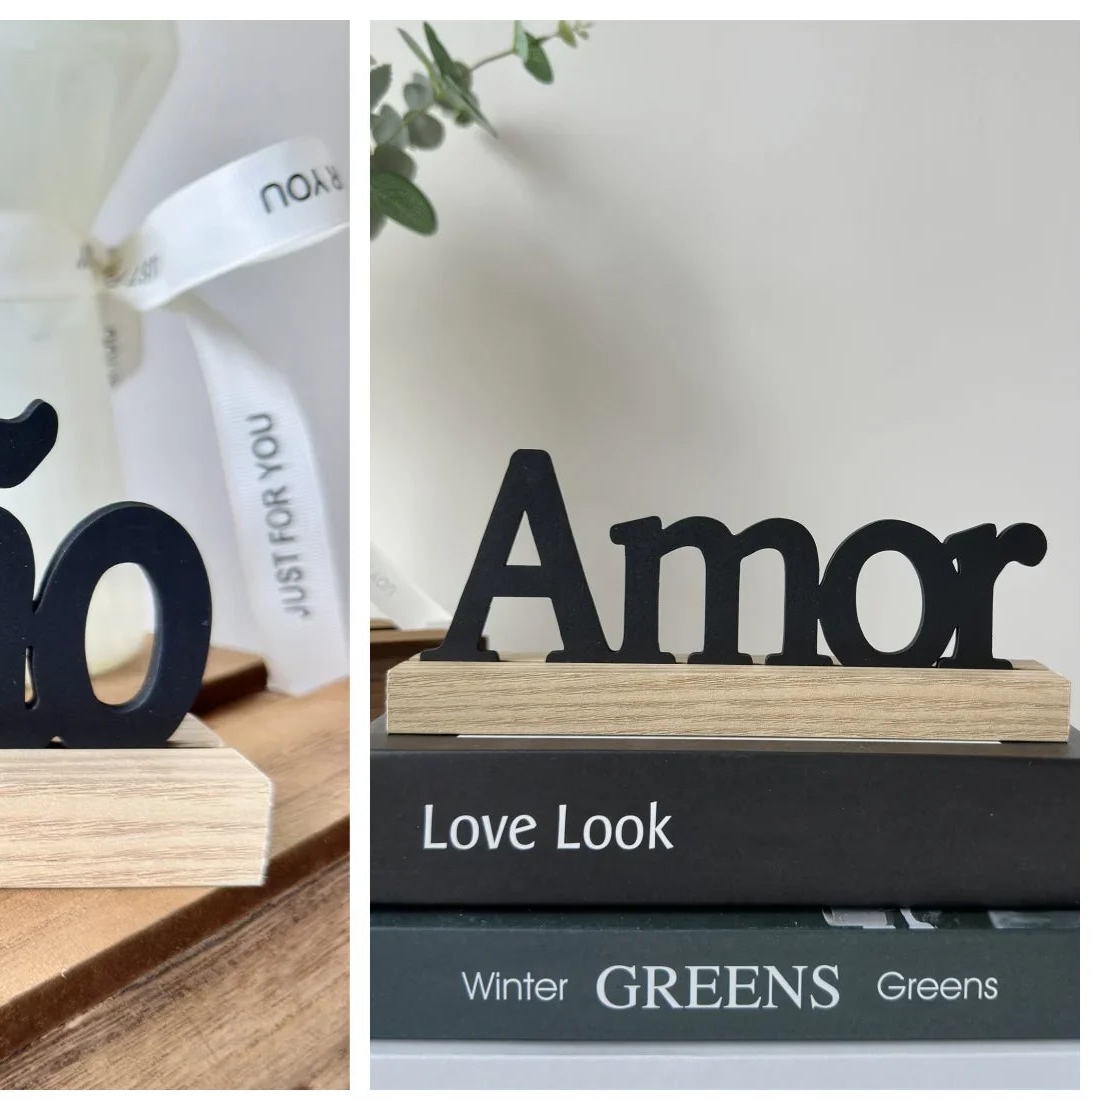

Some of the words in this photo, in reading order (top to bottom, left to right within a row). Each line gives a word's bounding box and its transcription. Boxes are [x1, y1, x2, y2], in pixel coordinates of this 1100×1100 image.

[260, 168, 330, 214] YOU
[245, 412, 284, 481] YOU
[261, 484, 296, 546] FOR
[271, 551, 312, 618] JUST
[420, 448, 1048, 668] Amor
[423, 804, 537, 850] Love
[557, 801, 674, 850] Look
[461, 971, 569, 1002] Winter
[596, 964, 841, 1010] GREENS
[877, 970, 999, 1001] Greens
